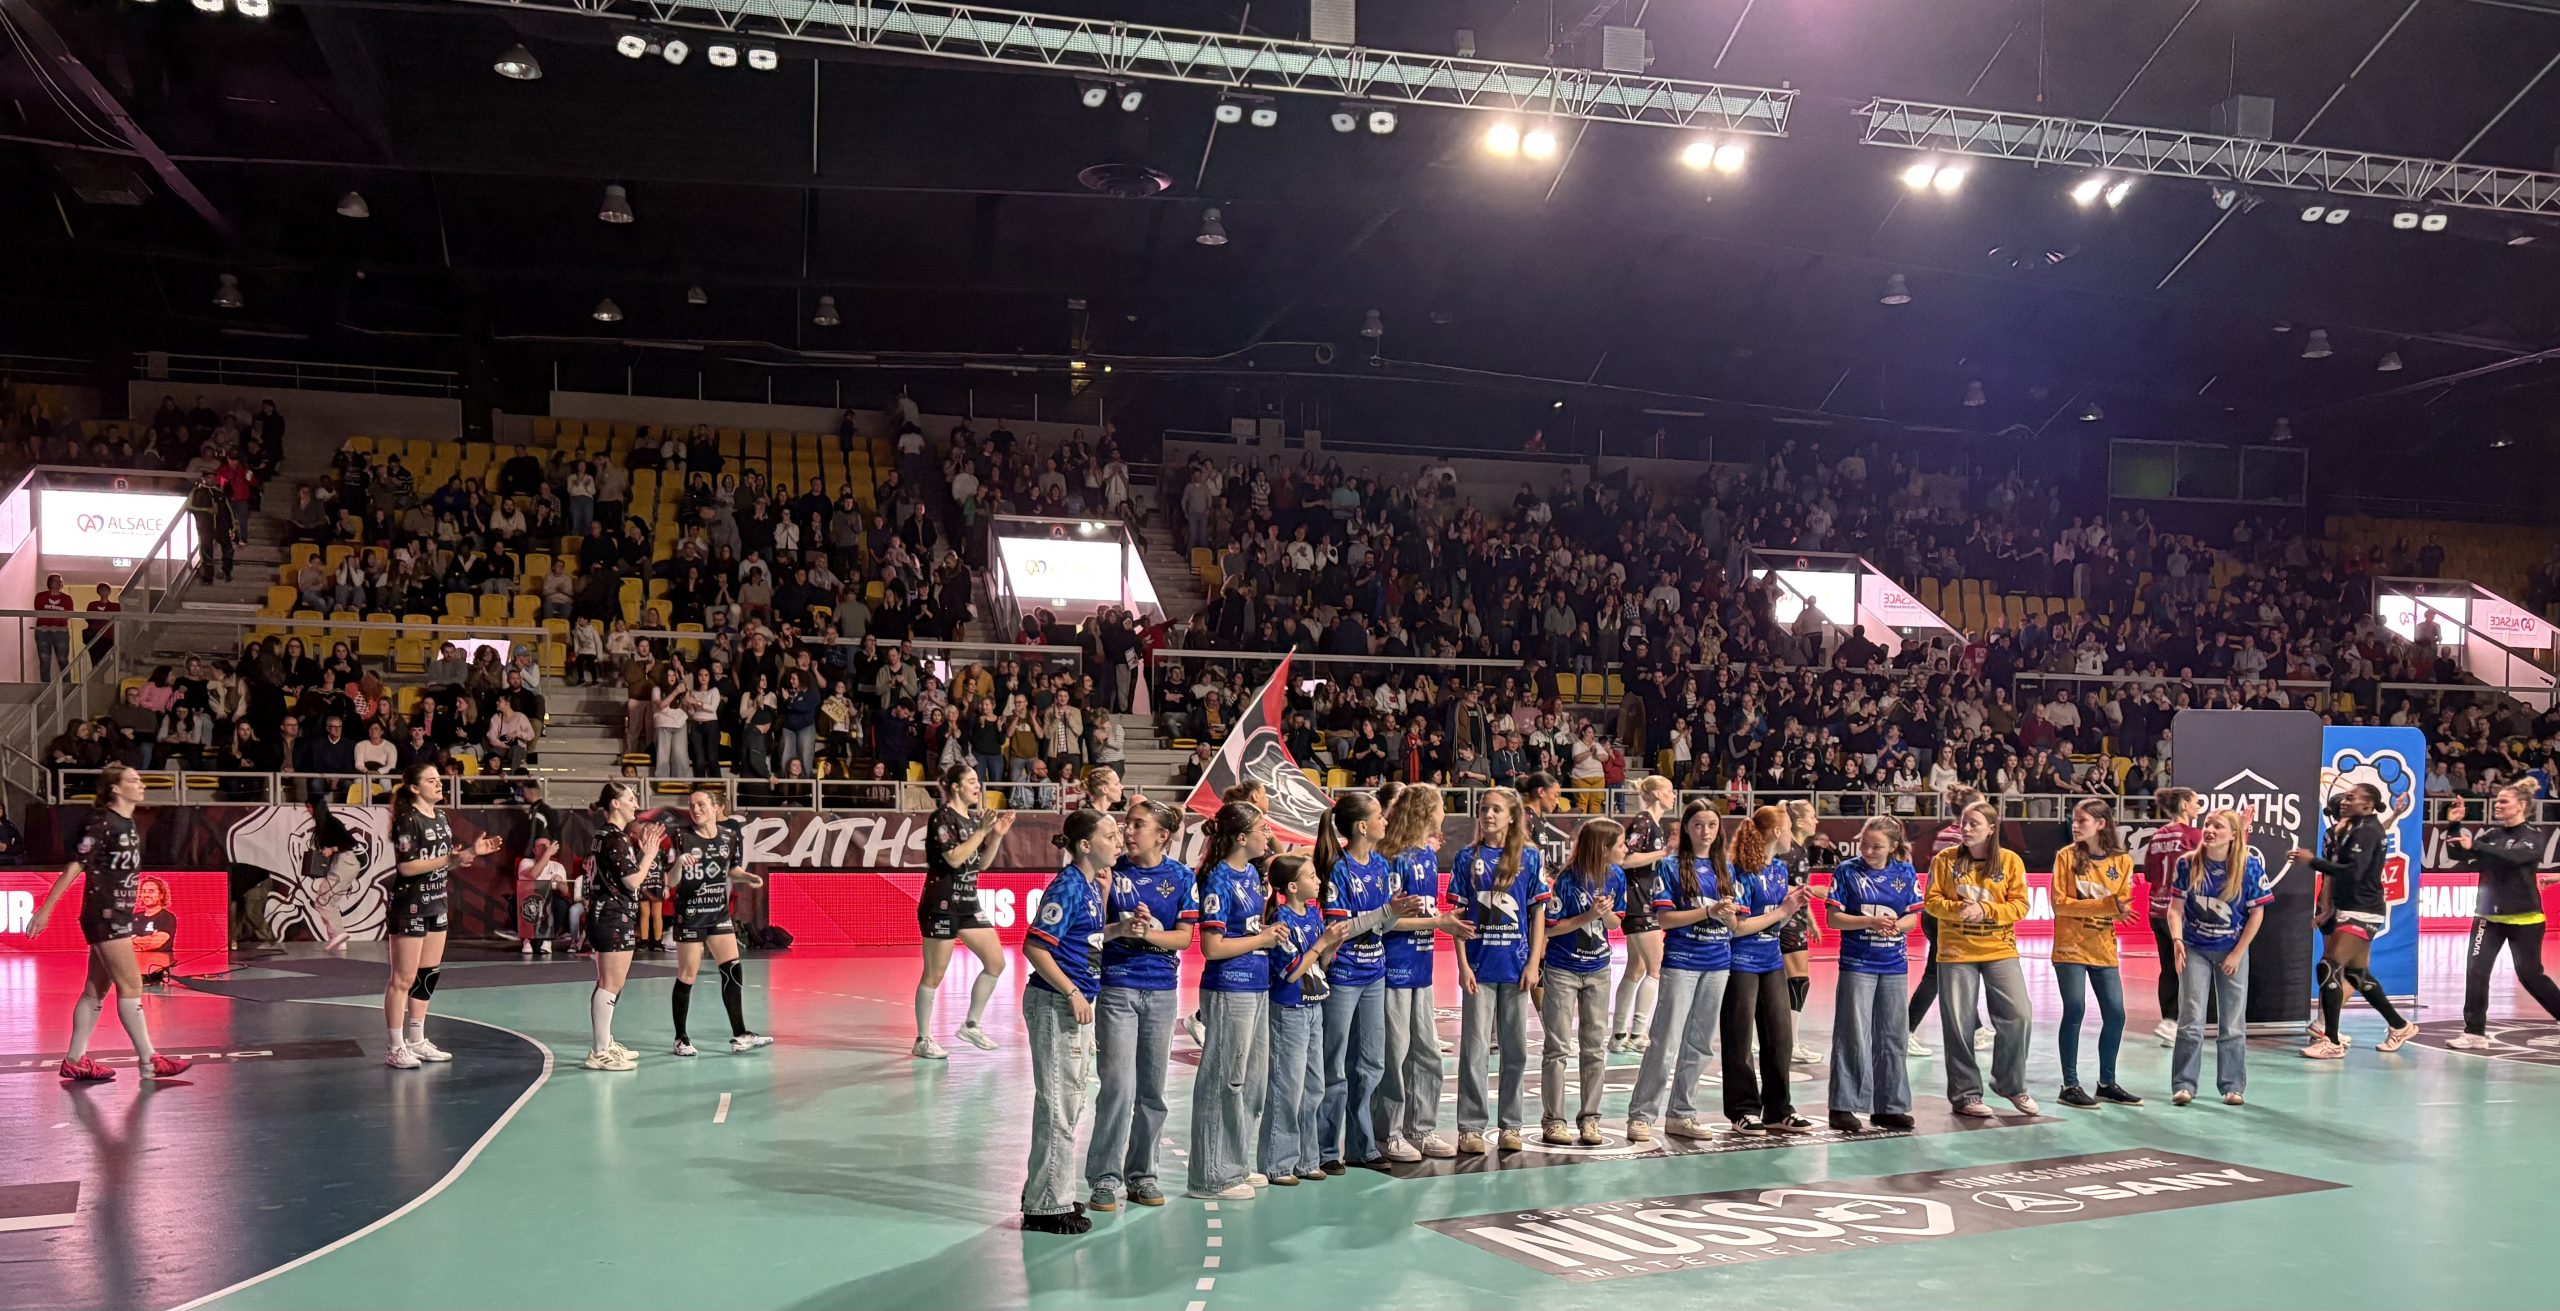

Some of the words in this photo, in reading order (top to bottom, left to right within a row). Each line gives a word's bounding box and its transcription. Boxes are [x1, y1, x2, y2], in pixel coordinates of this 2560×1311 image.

[108, 516, 164, 531] ALSACE
[109, 851, 132, 870] 72
[684, 862, 704, 880] 35
[1939, 1157, 2178, 1189] CONCESSIONNAIRE
[2063, 1168, 2265, 1201] SANY
[1516, 1199, 1676, 1222] GROUPE
[1465, 1202, 1846, 1268] NUSS
